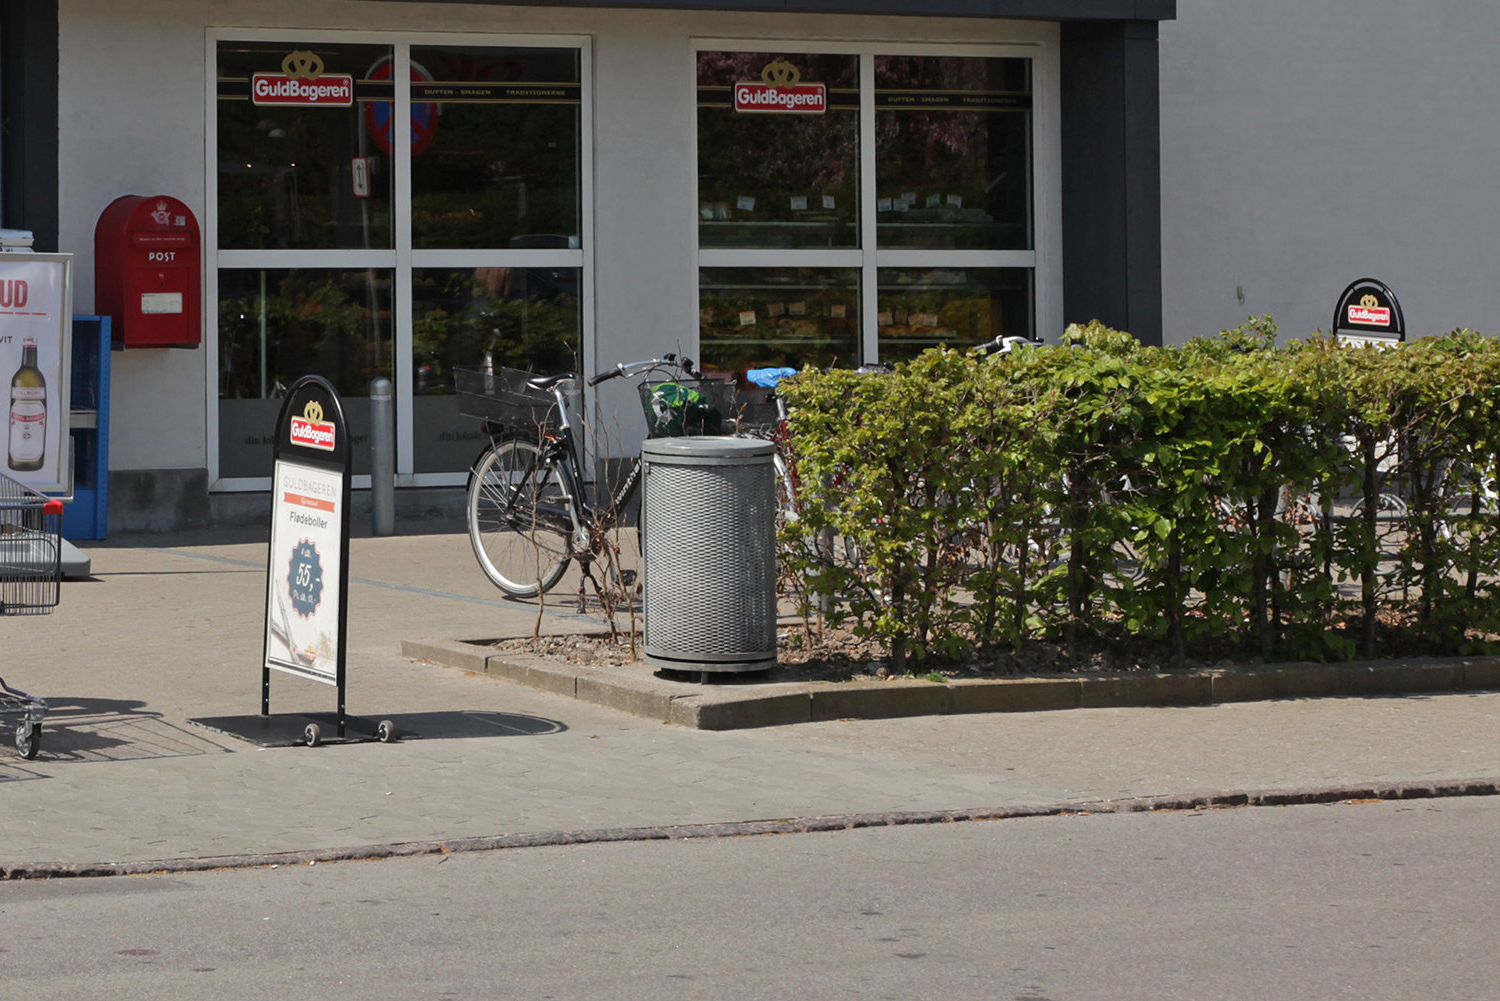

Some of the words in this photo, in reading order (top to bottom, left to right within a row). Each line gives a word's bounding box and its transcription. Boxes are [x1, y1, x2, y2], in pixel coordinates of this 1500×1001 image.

[256, 80, 349, 101] GuldBageren
[738, 88, 823, 108] GuldBageren
[148, 252, 176, 262] POST
[292, 422, 334, 444] GuldBageren
[283, 475, 336, 496] GULDBAGEREN
[290, 511, 328, 529] Flødeboller
